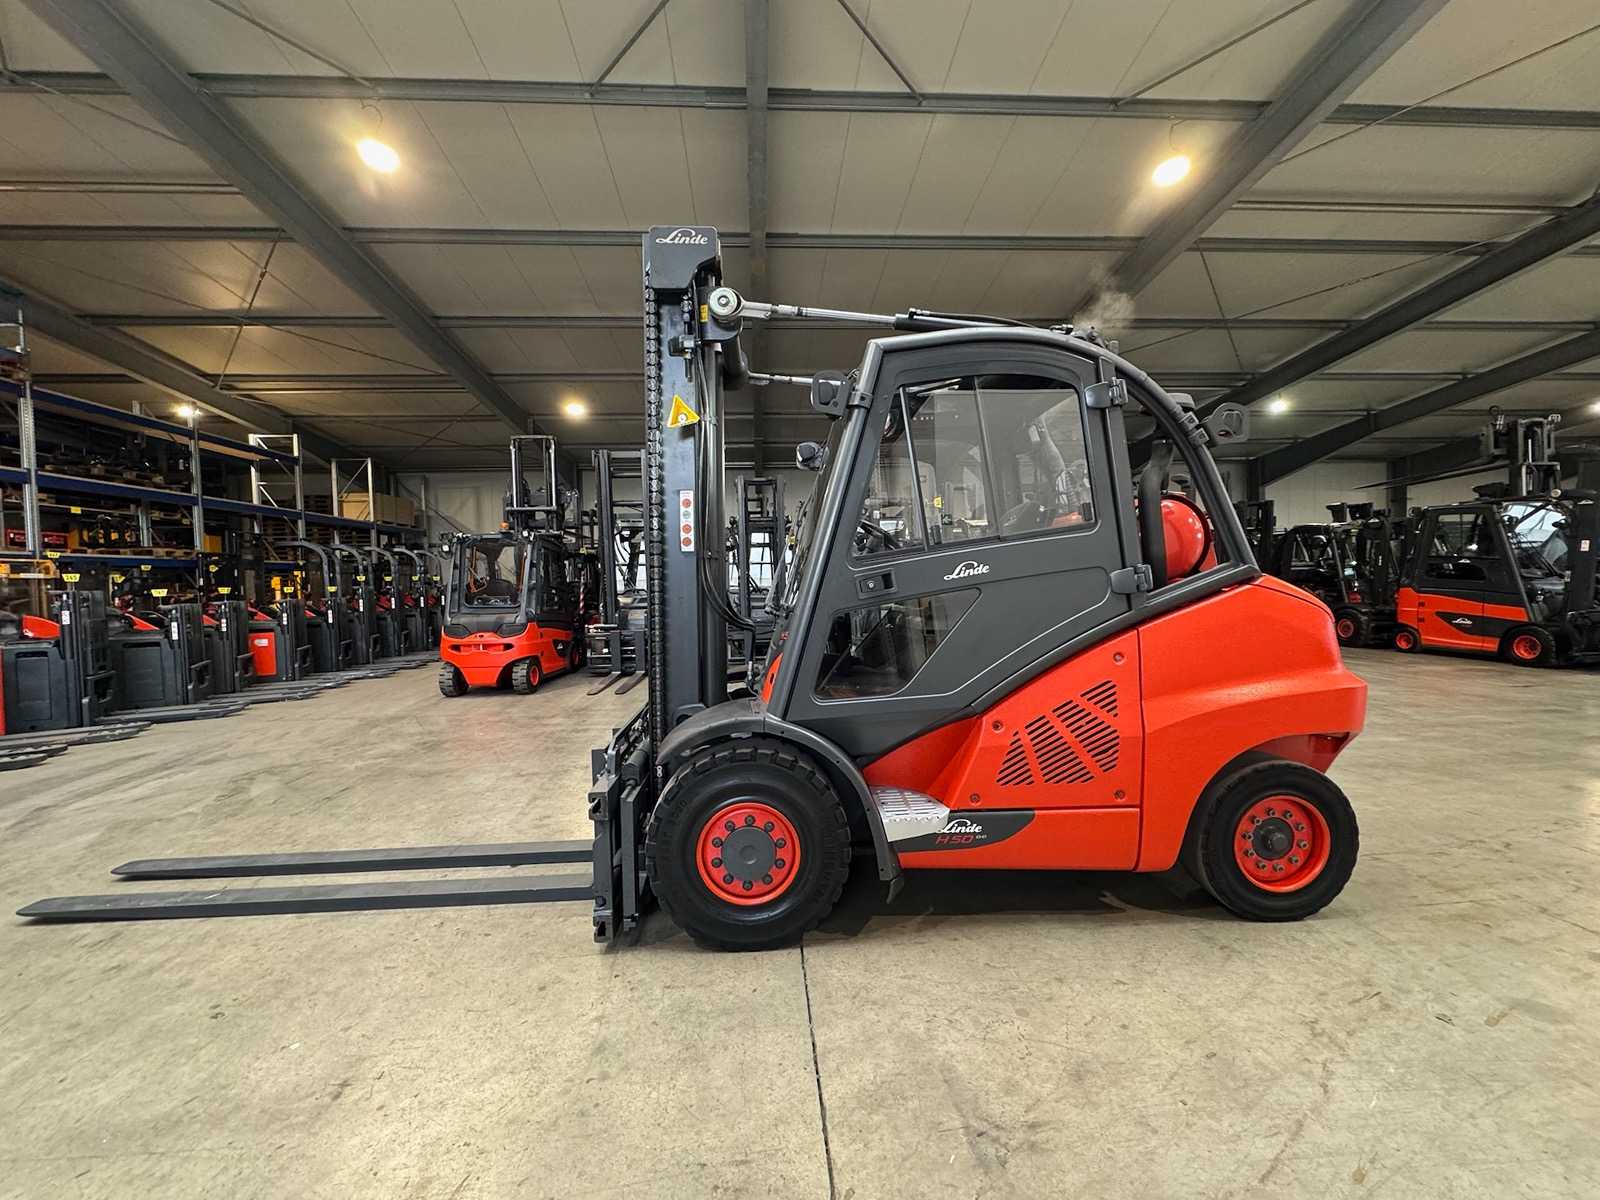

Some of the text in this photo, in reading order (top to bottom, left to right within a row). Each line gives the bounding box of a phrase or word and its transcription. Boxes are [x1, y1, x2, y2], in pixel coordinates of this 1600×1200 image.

[656, 228, 708, 245] Linde
[943, 560, 990, 580] Linde
[937, 818, 983, 834] Linde
